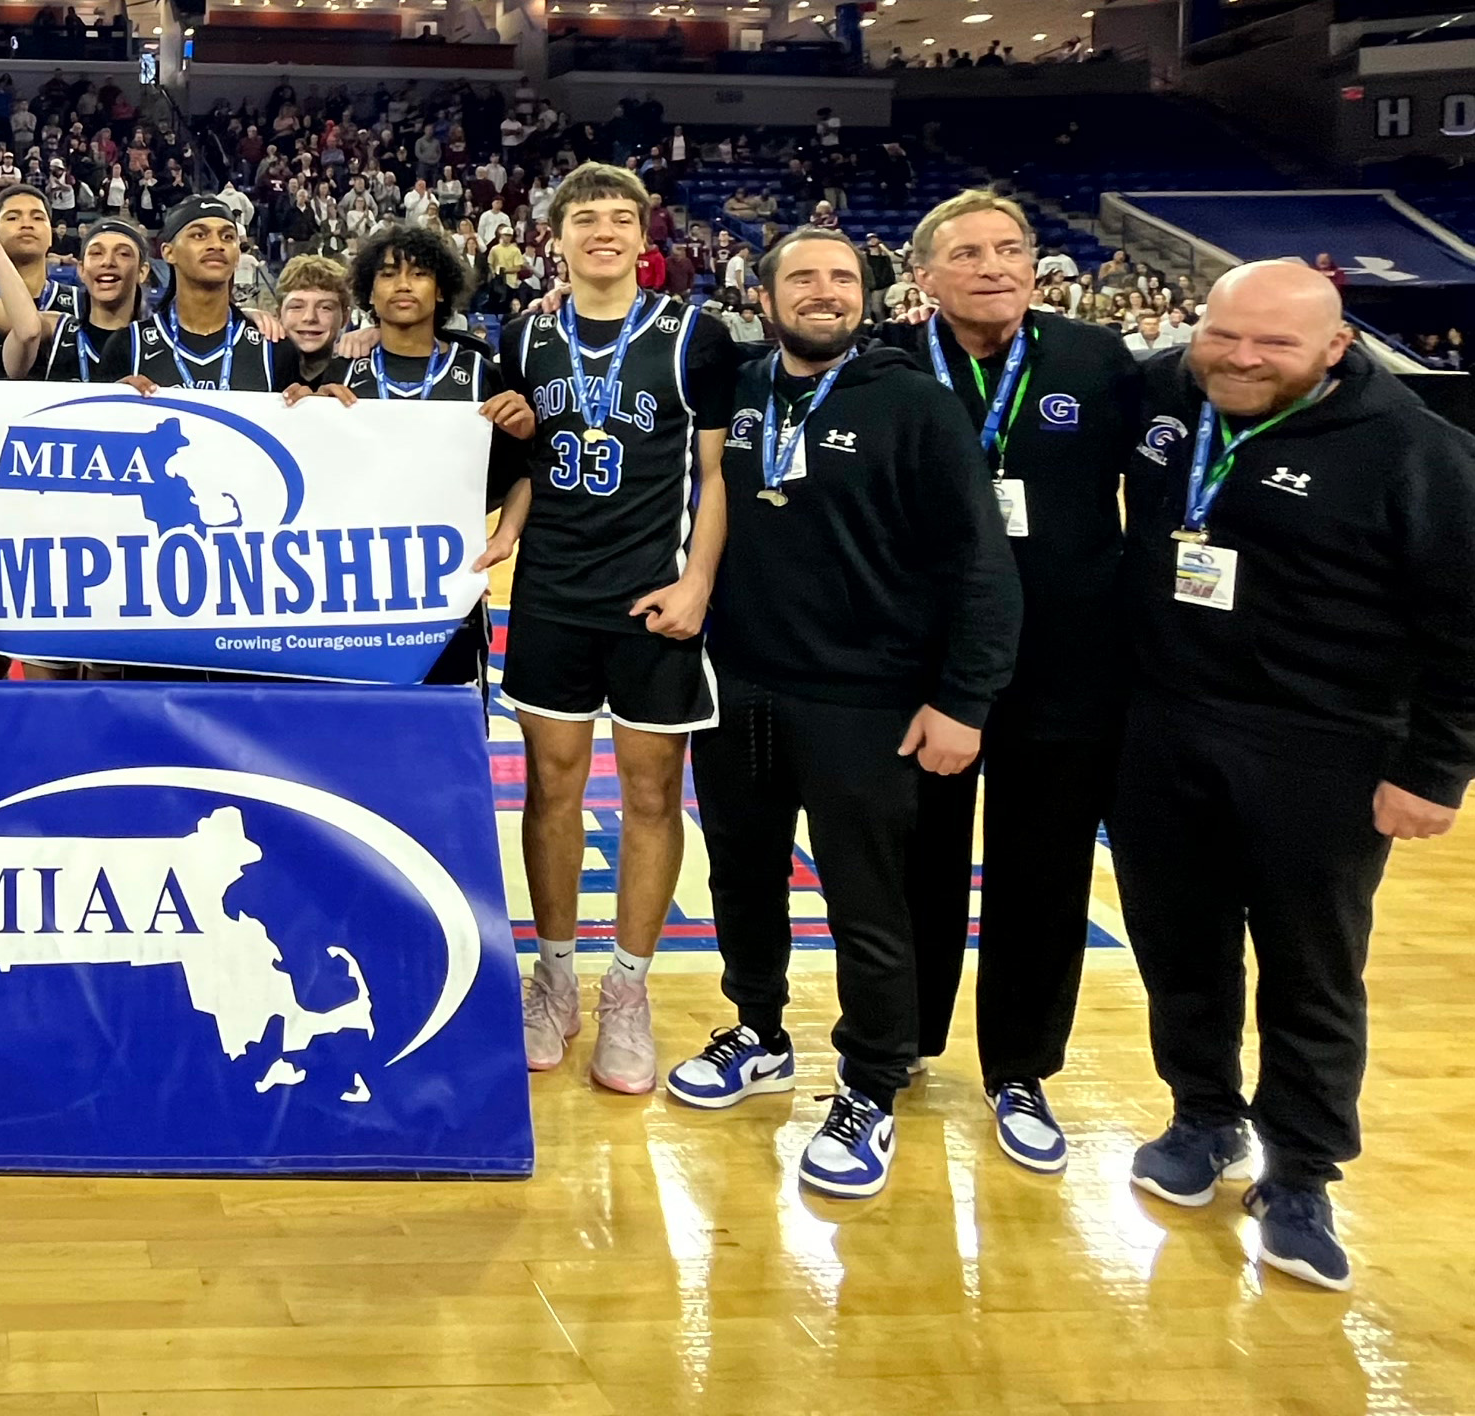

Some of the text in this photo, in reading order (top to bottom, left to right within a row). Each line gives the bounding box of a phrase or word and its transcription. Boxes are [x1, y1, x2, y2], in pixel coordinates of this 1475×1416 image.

[661, 318, 678, 331] MT
[533, 376, 657, 432] ROYALS
[1039, 393, 1081, 425] G
[8, 439, 155, 485] MIAA
[550, 431, 624, 496] 33
[215, 634, 282, 653] Growing
[286, 632, 383, 651] Courageous
